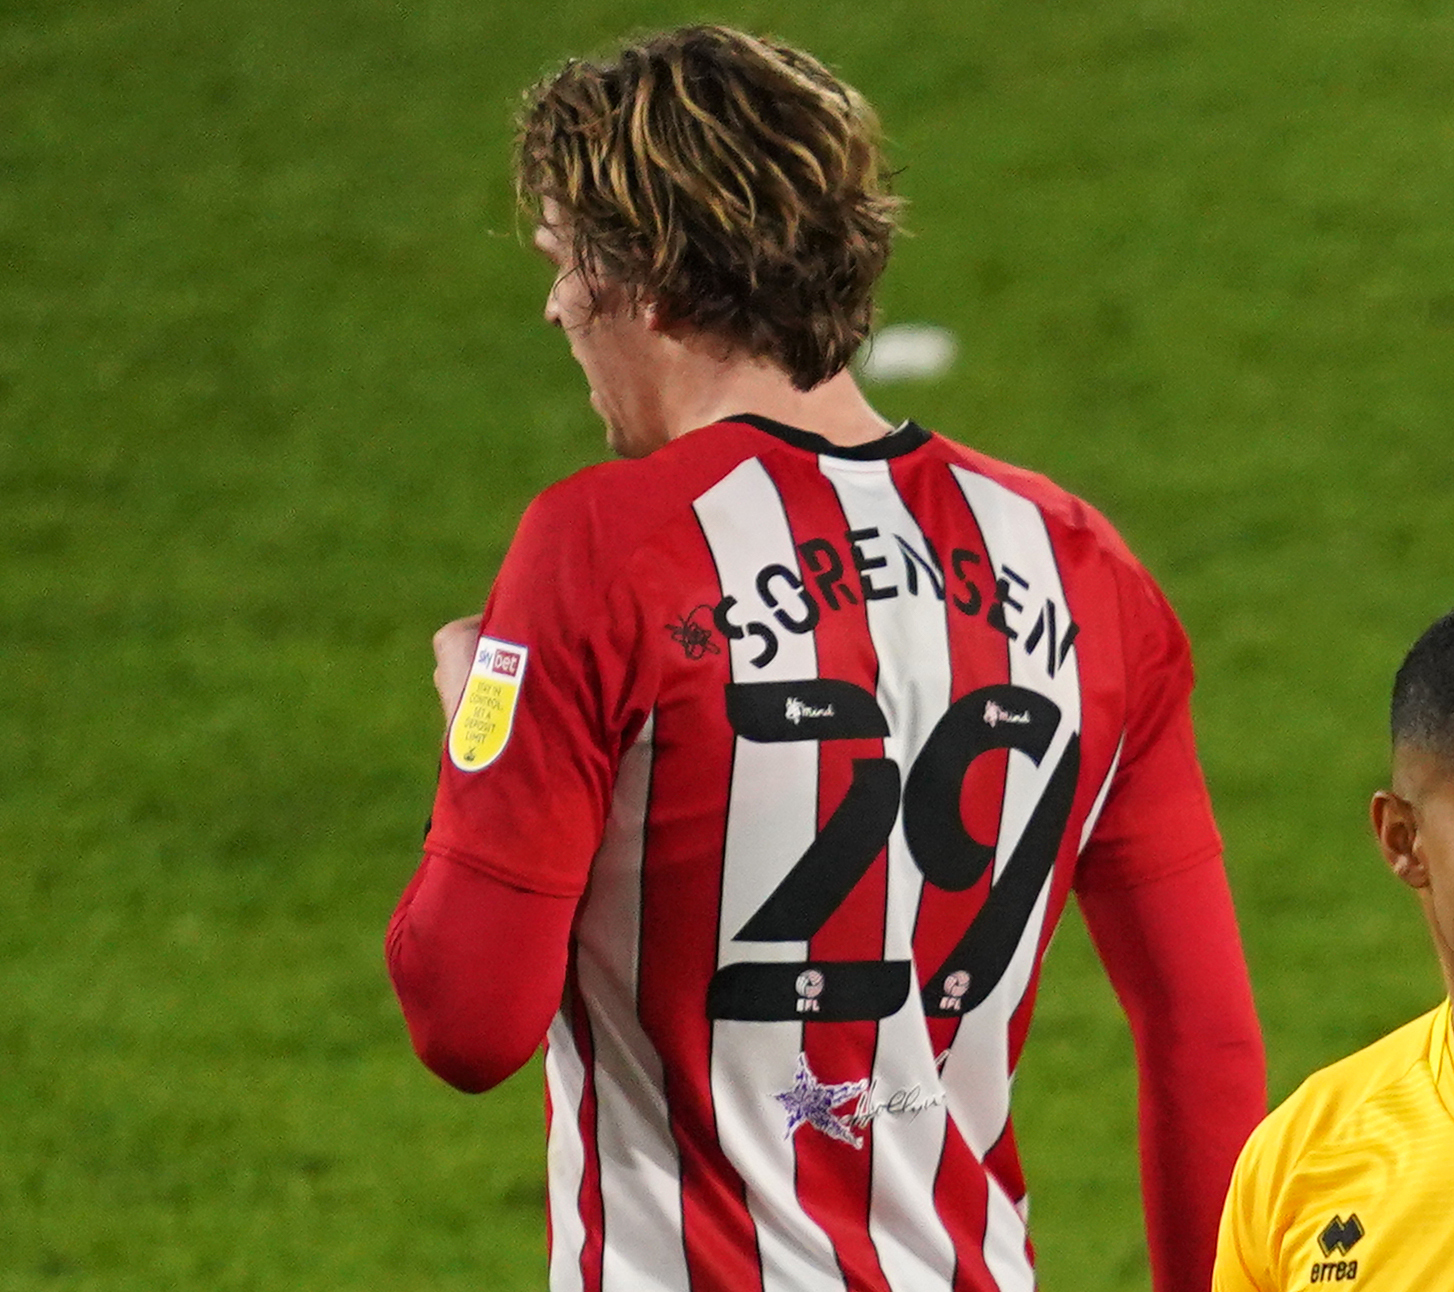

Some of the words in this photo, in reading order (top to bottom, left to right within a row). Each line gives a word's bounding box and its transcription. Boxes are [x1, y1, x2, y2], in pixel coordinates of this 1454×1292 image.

[714, 527, 1080, 678] SORENSEN
[802, 702, 835, 719] mind
[706, 678, 1081, 1022] 29
[1310, 1261, 1358, 1284] errea
